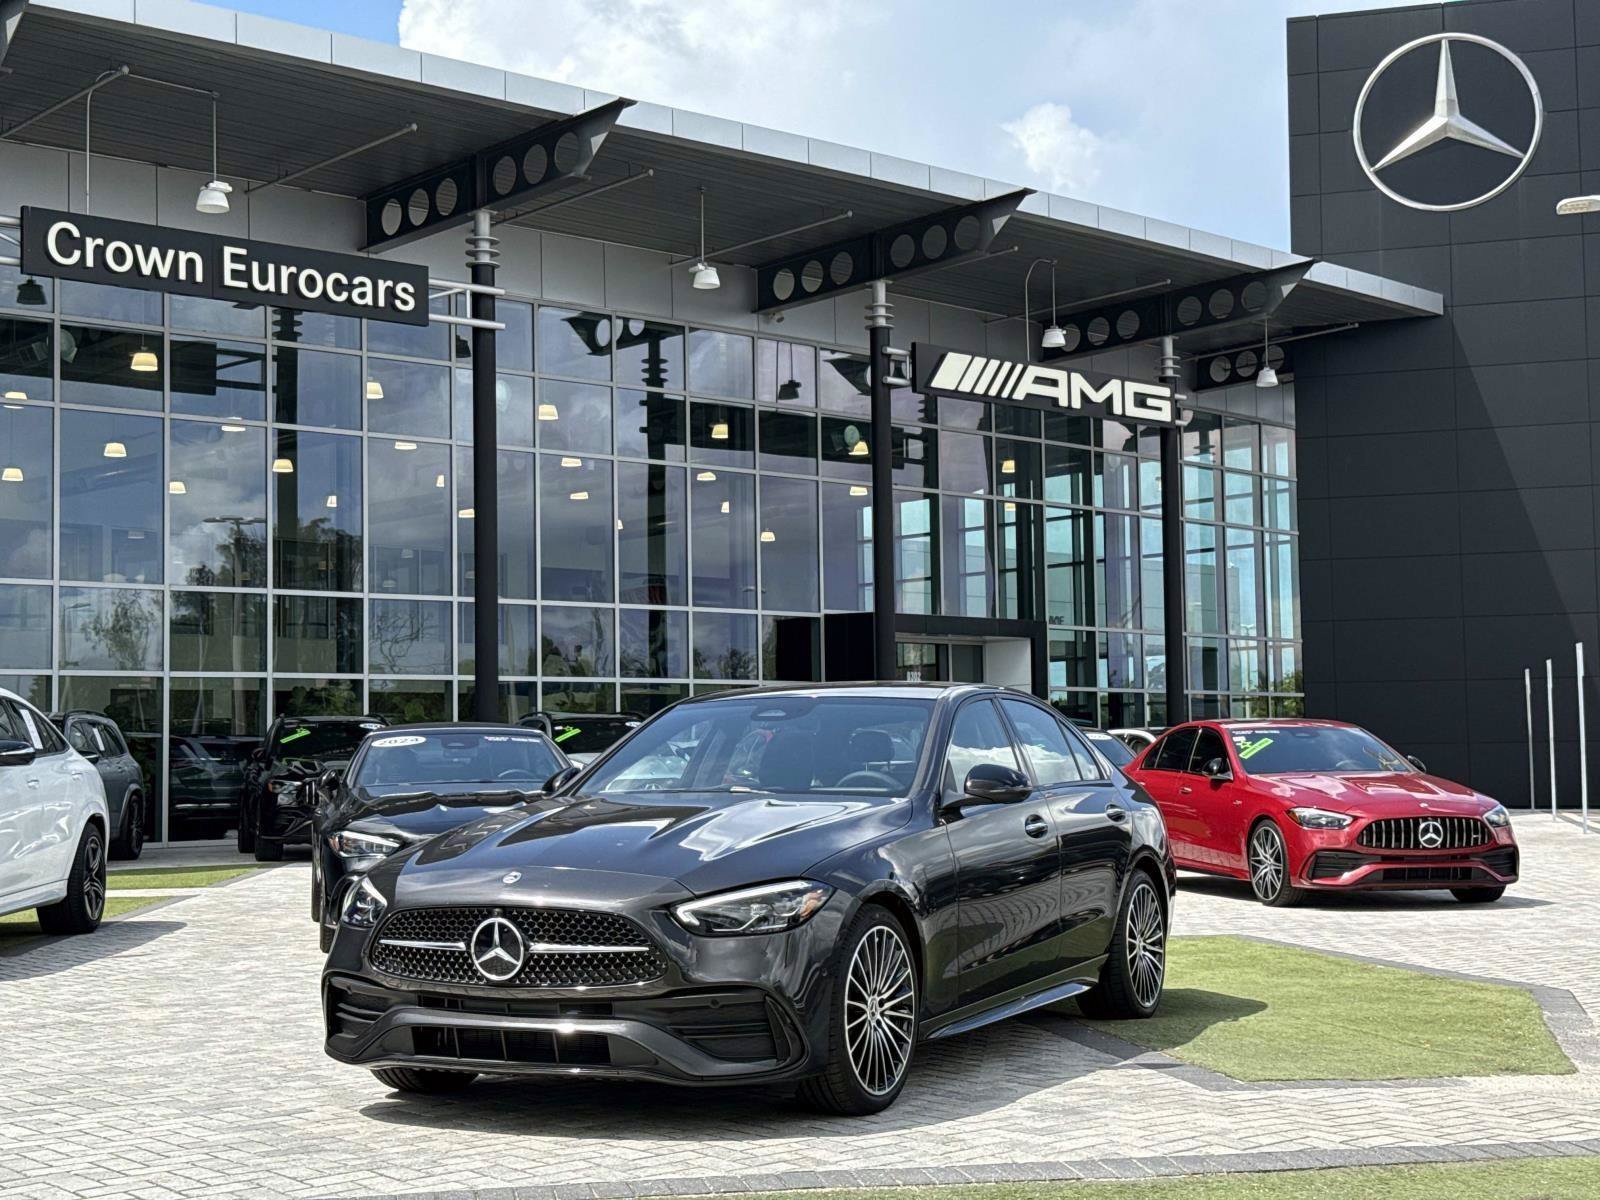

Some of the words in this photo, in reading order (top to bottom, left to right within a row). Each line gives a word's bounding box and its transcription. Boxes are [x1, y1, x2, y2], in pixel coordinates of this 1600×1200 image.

[46, 221, 204, 283] Crown
[223, 245, 416, 312] Eurocars
[1012, 365, 1171, 422] AMG
